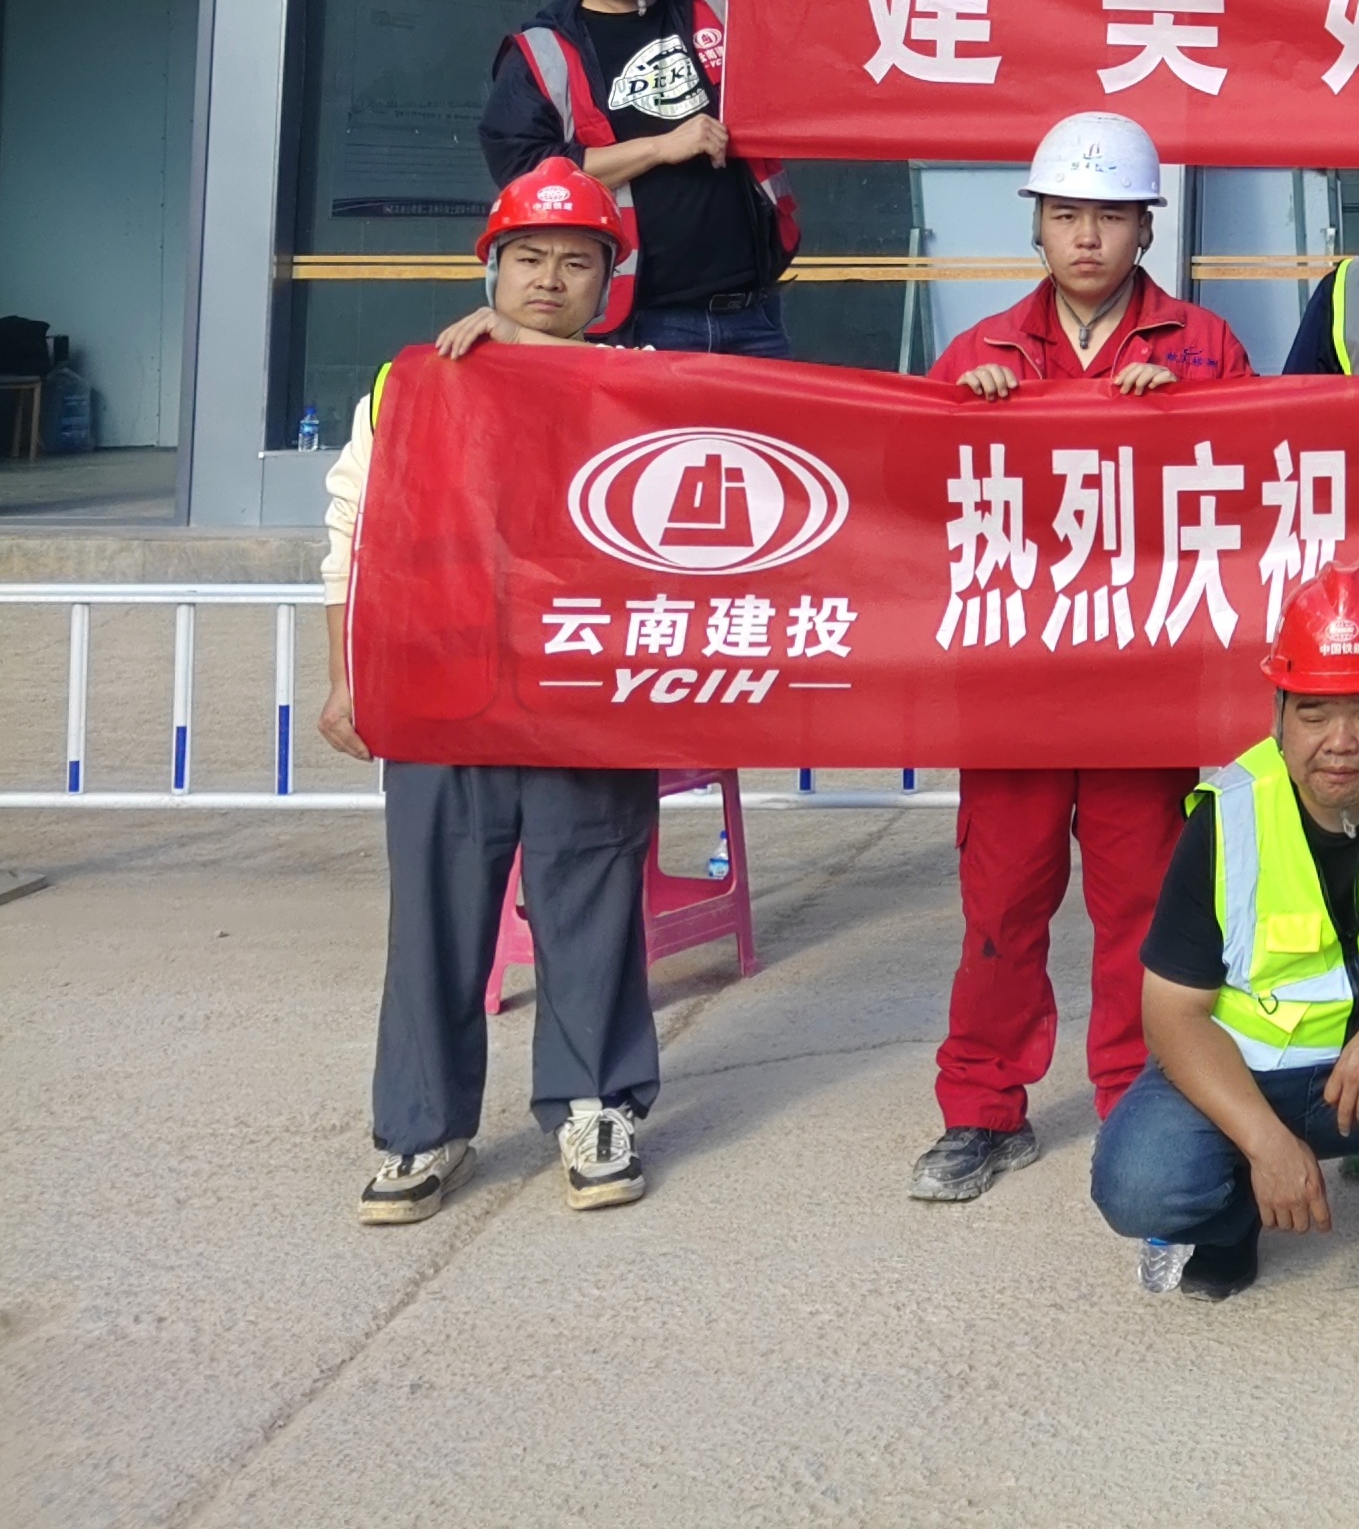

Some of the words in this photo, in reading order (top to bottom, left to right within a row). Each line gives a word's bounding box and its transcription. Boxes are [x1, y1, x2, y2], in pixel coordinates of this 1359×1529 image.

[541, 592, 859, 659] 云南建投
[611, 668, 779, 704] YCIH
